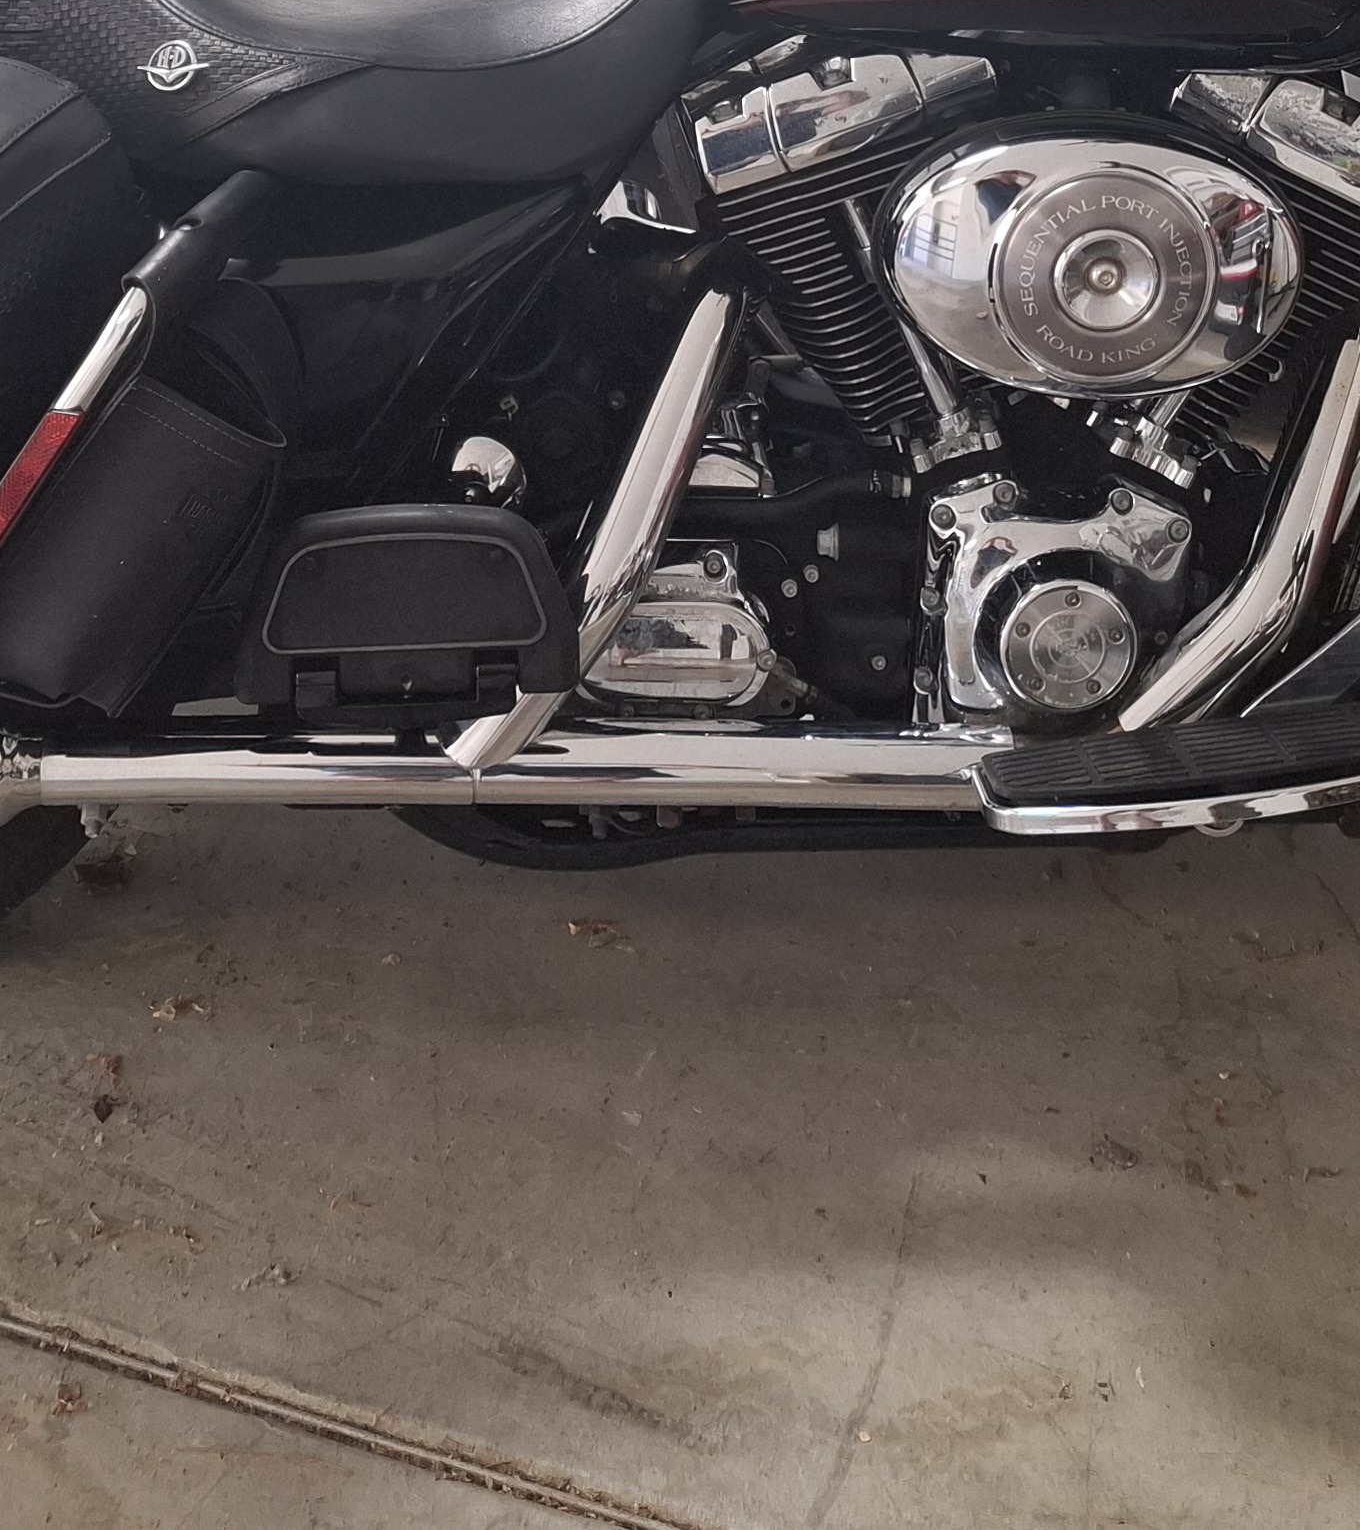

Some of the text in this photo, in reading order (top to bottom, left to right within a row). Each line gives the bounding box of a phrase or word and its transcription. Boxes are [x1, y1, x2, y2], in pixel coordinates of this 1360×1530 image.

[1019, 194, 1193, 327] SEQUENTIAL PORT INJECTION
[1036, 323, 1157, 365] ROAD KING
